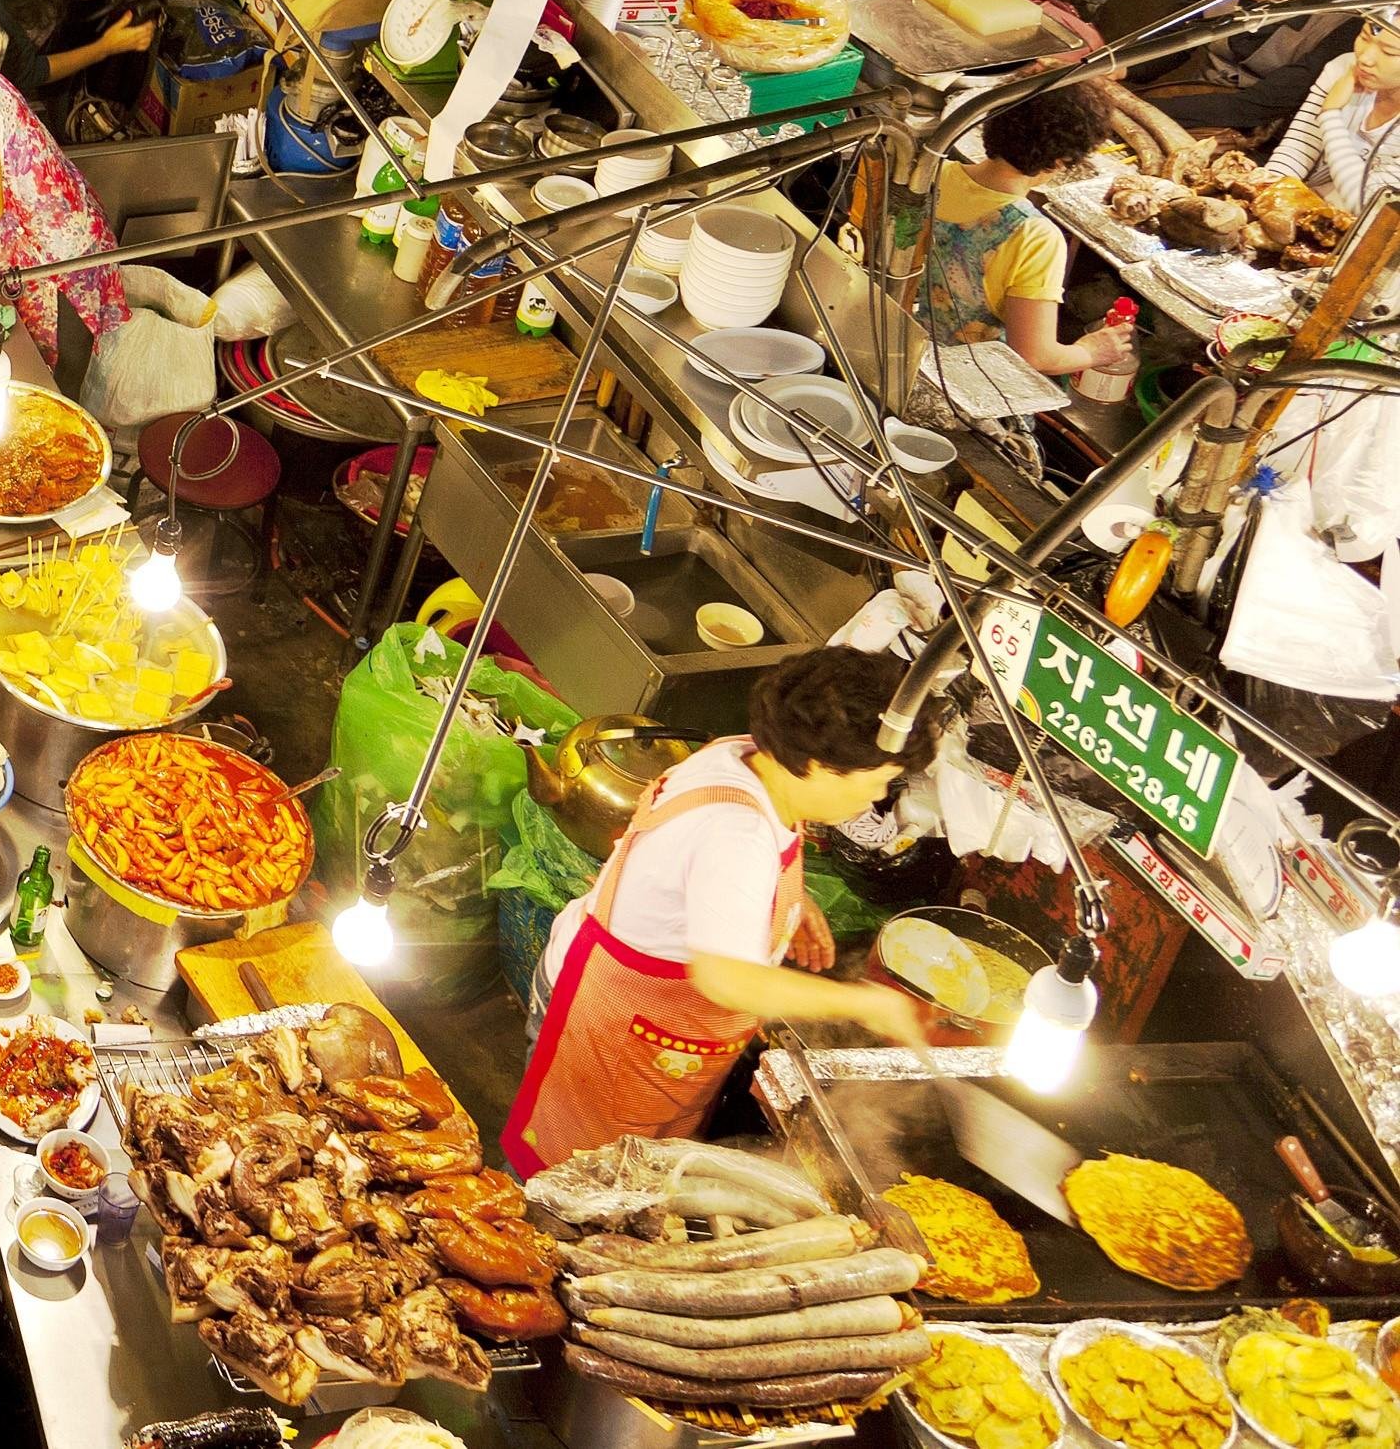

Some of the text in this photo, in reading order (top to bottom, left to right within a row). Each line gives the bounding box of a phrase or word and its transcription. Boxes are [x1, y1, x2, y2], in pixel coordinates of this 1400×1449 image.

[990, 623, 1018, 659] 65
[1038, 633, 1222, 803] 자선네
[1045, 700, 1199, 836] 2263-2845
[1139, 852, 1211, 923] 삼화호일
